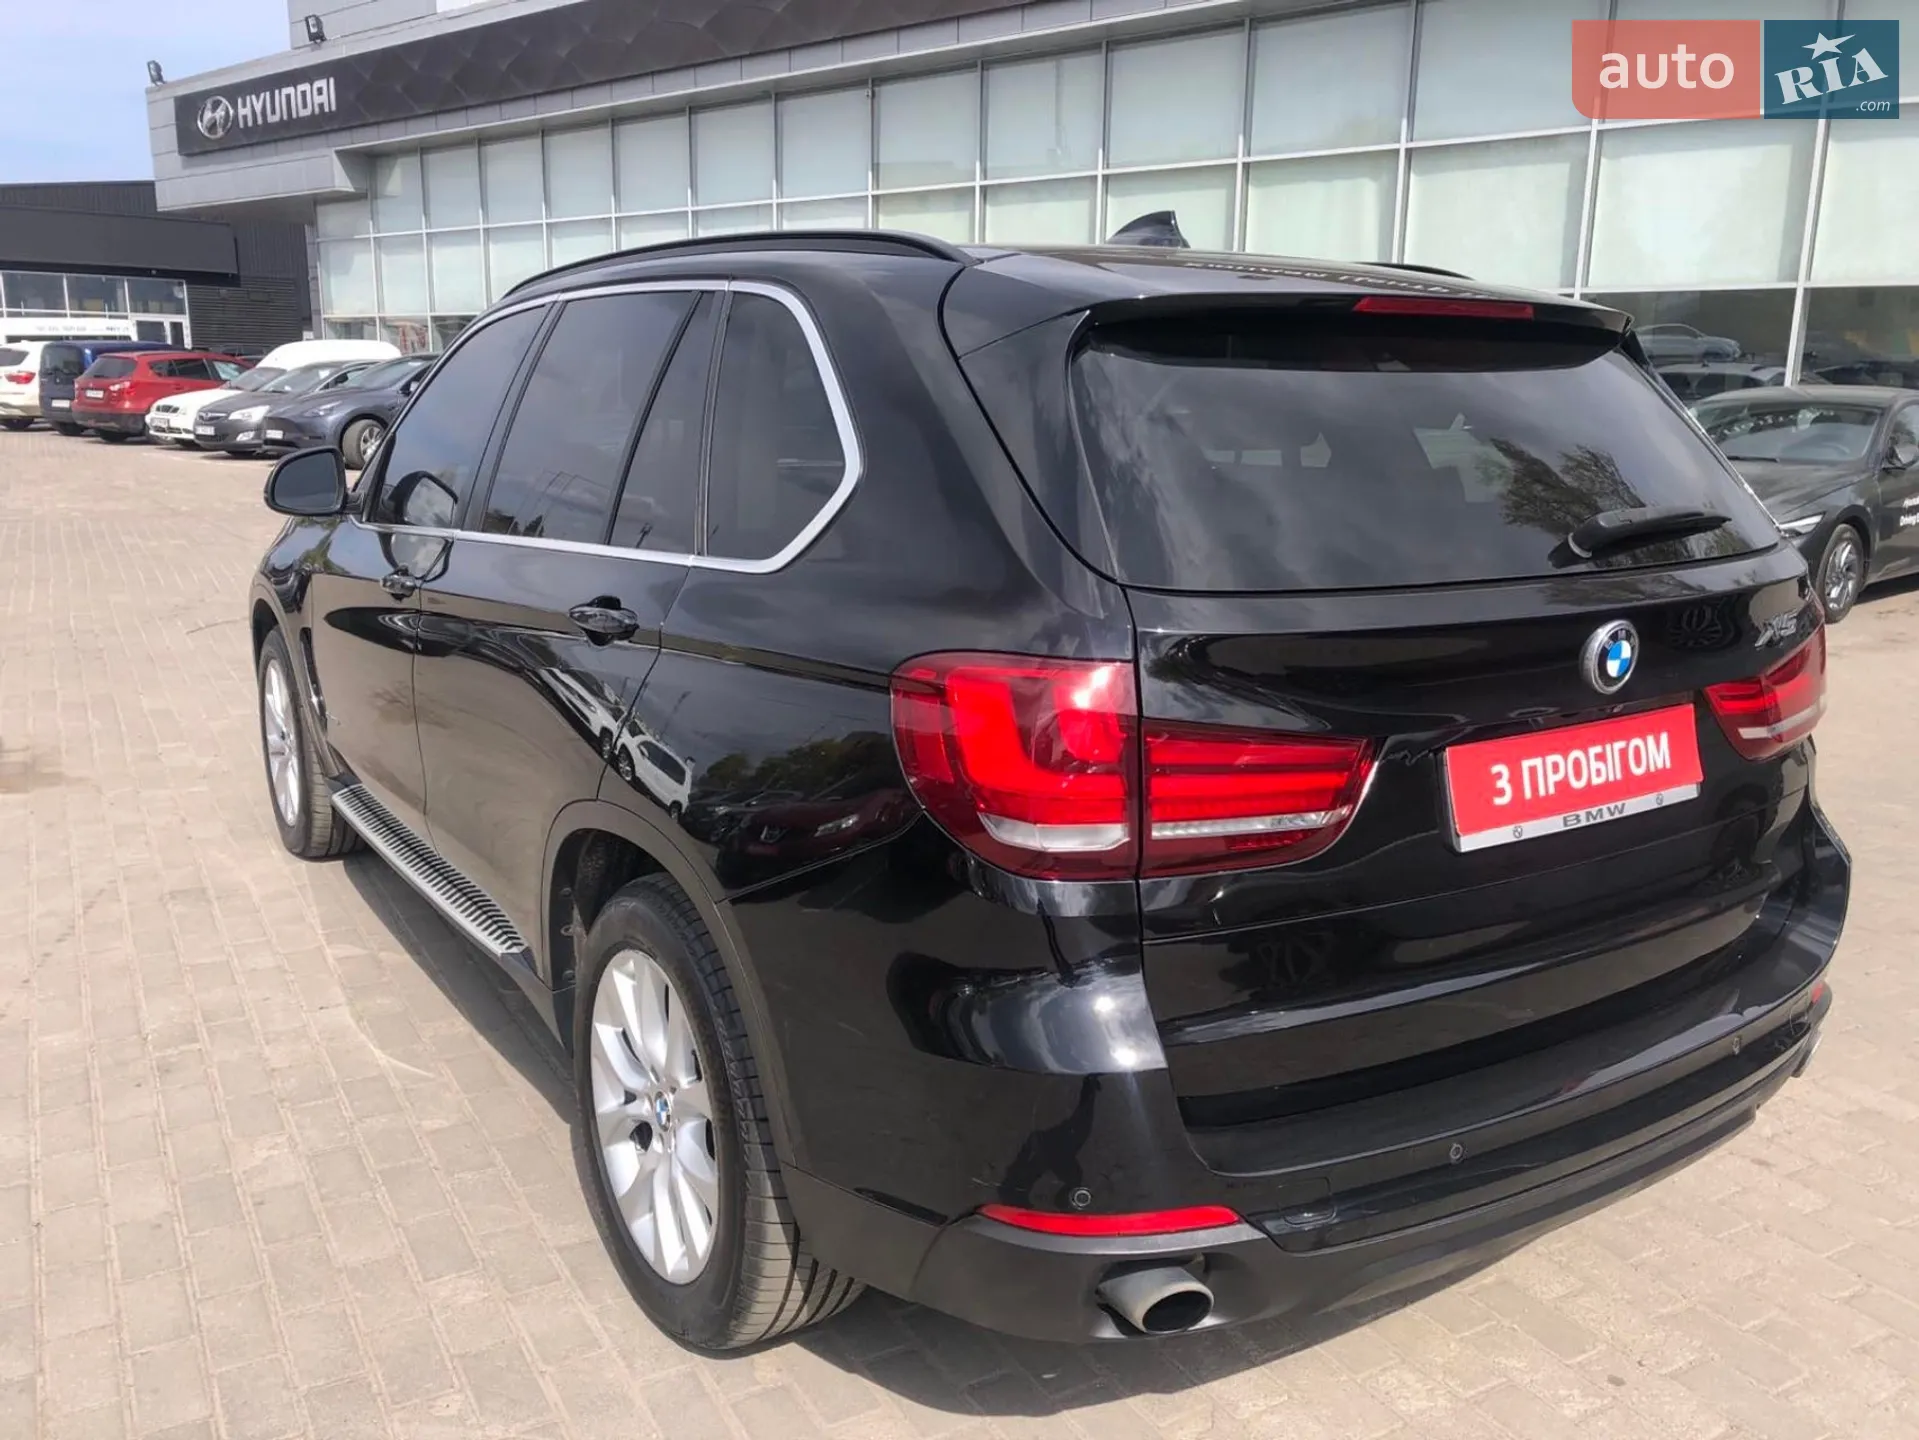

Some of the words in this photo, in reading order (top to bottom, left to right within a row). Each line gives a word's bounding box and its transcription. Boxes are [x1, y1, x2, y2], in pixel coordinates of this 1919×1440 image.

[237, 76, 337, 129] HYUNDAI
[1754, 608, 1798, 648] X5
[1490, 763, 1513, 806] З
[1520, 731, 1671, 800] ПРОБІГОМ
[1562, 802, 1627, 828] BMW
